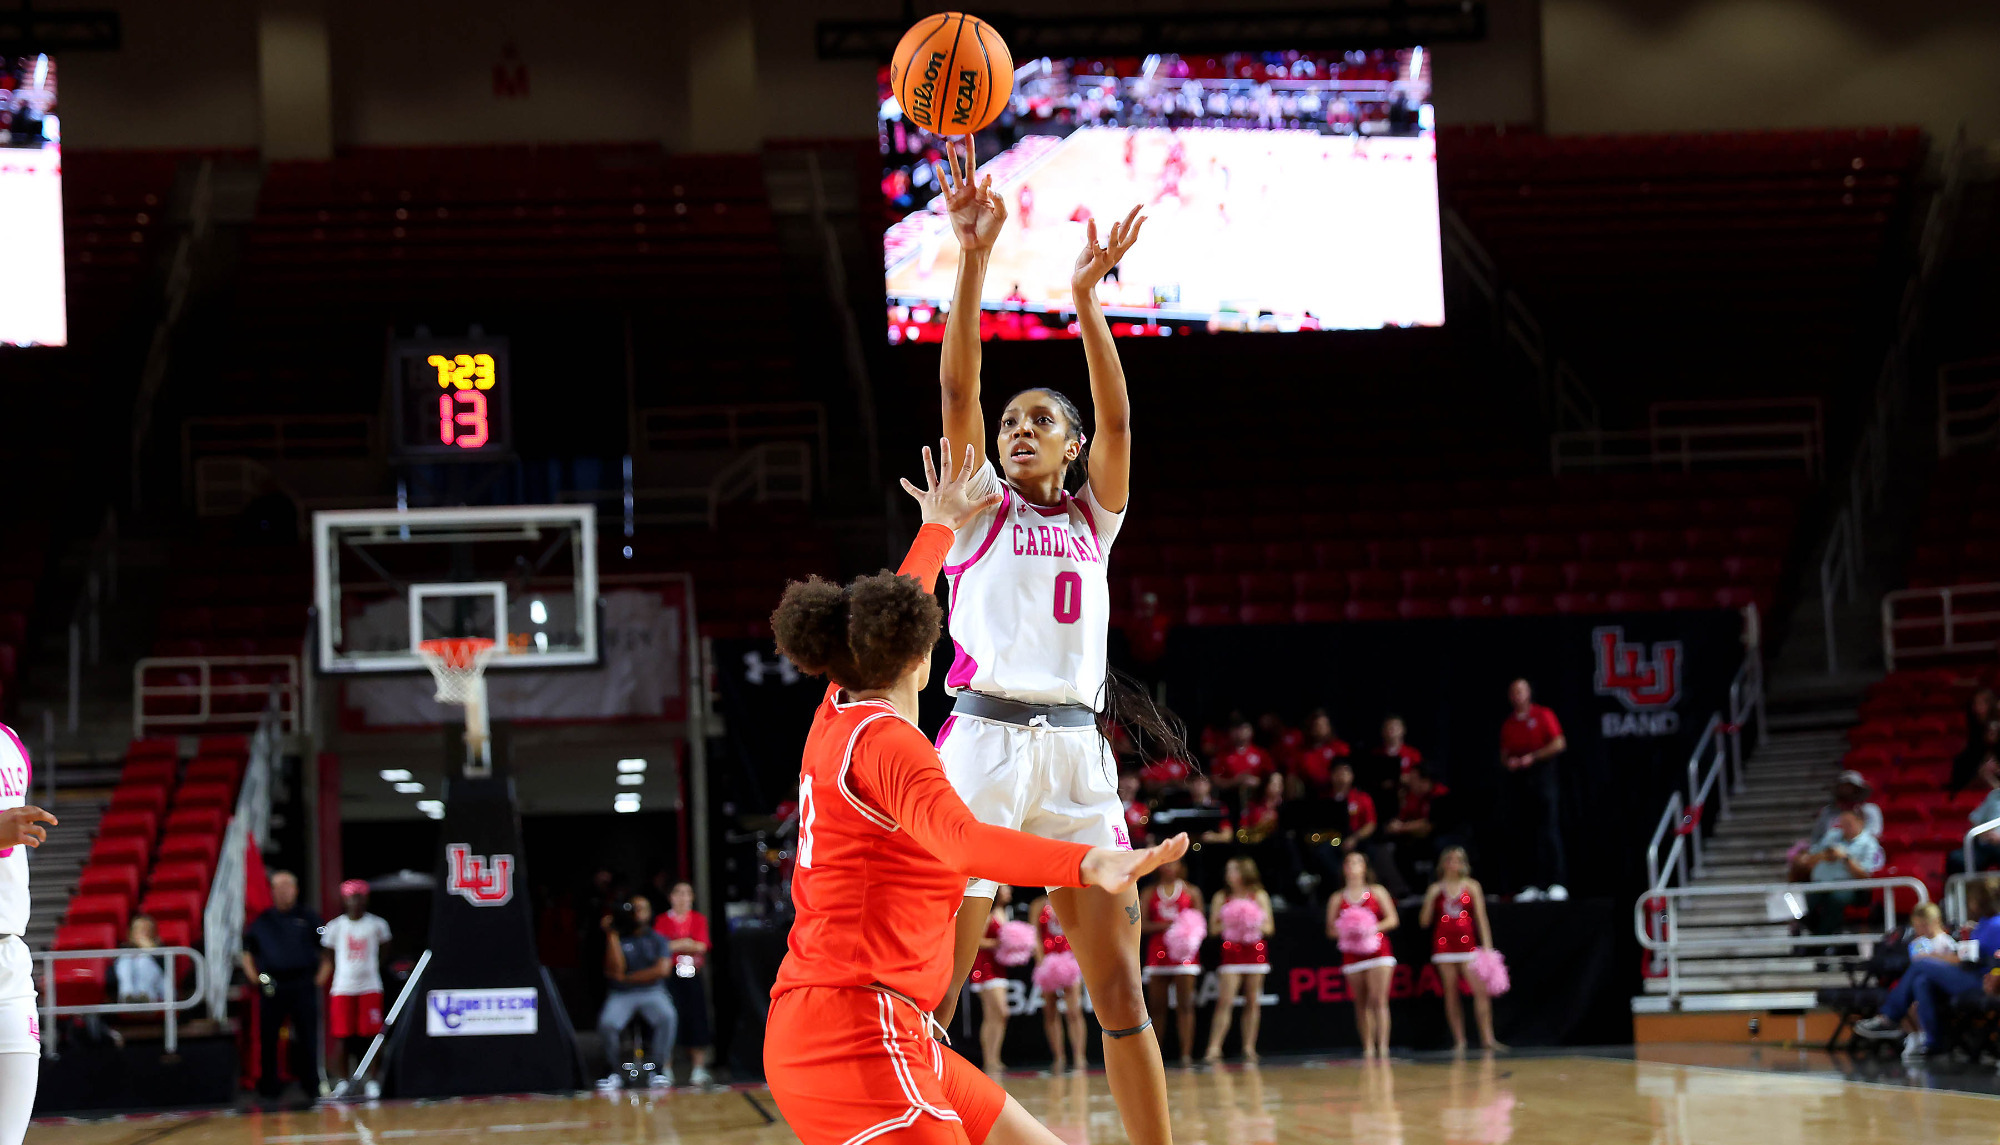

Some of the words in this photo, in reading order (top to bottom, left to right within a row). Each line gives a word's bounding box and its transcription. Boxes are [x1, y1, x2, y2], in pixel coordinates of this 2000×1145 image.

[912, 51, 947, 126] Wilson
[952, 69, 979, 126] NCAA
[427, 353, 496, 390] 7:23
[439, 389, 489, 449] 13
[1053, 571, 1082, 624] 0
[1593, 625, 1683, 712] LU
[1601, 712, 1680, 738] BAND
[446, 843, 514, 907] LU
